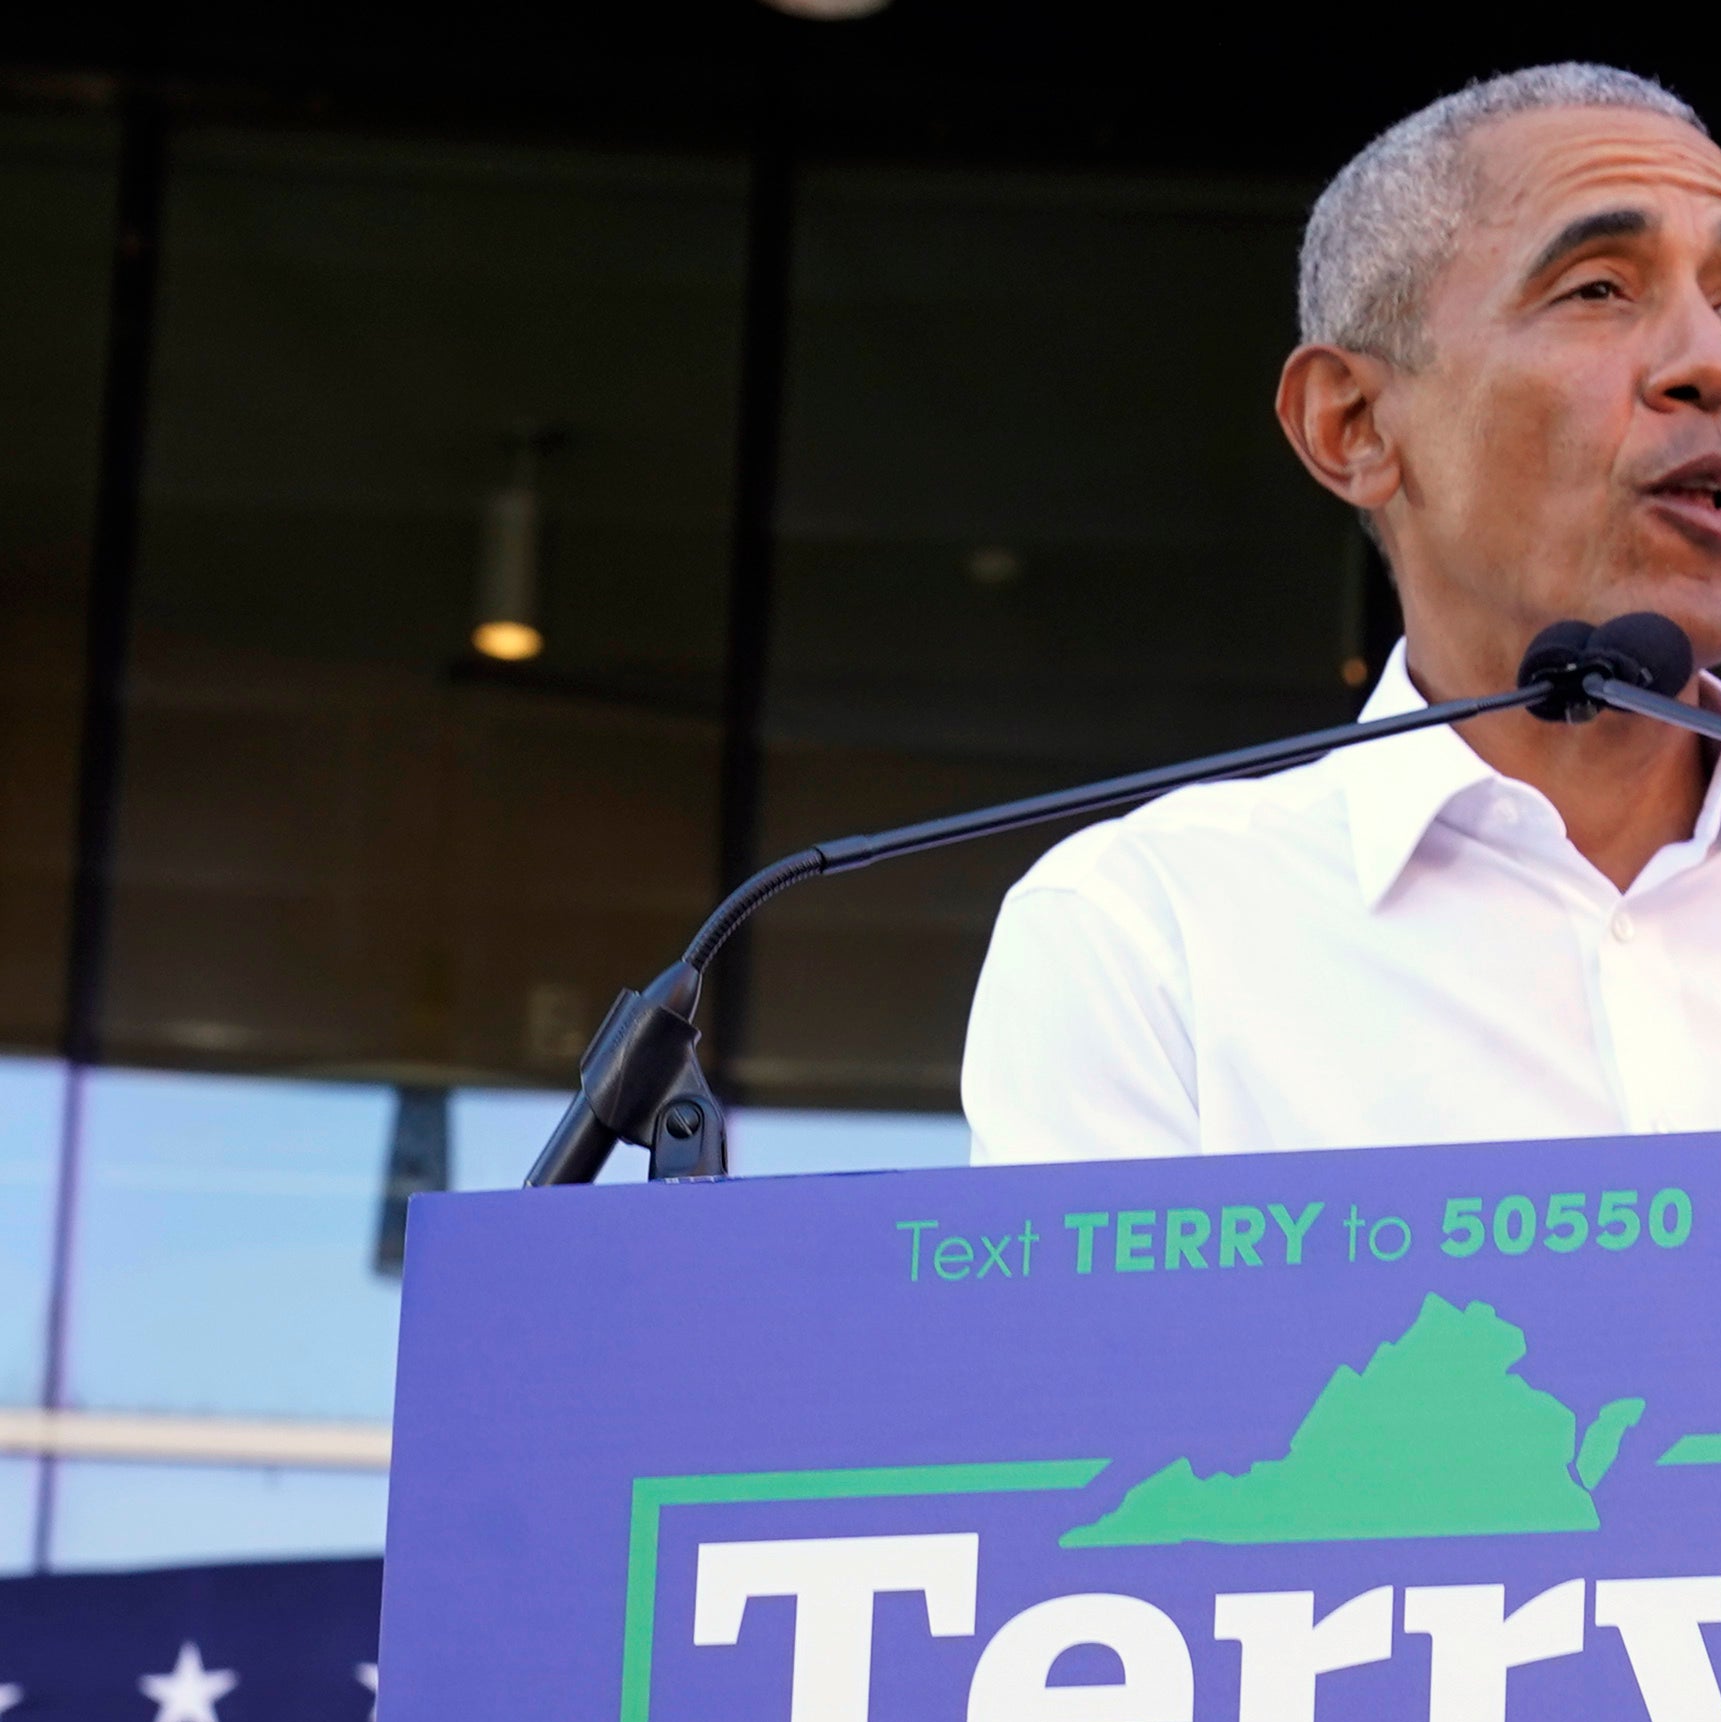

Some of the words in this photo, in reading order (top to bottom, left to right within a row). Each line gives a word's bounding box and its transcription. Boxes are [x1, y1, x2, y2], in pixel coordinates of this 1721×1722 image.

[896, 1219, 1040, 1281] Text
[1064, 1203, 1325, 1275] TERRY
[1343, 1205, 1412, 1262] to
[1440, 1188, 1694, 1258] 50550
